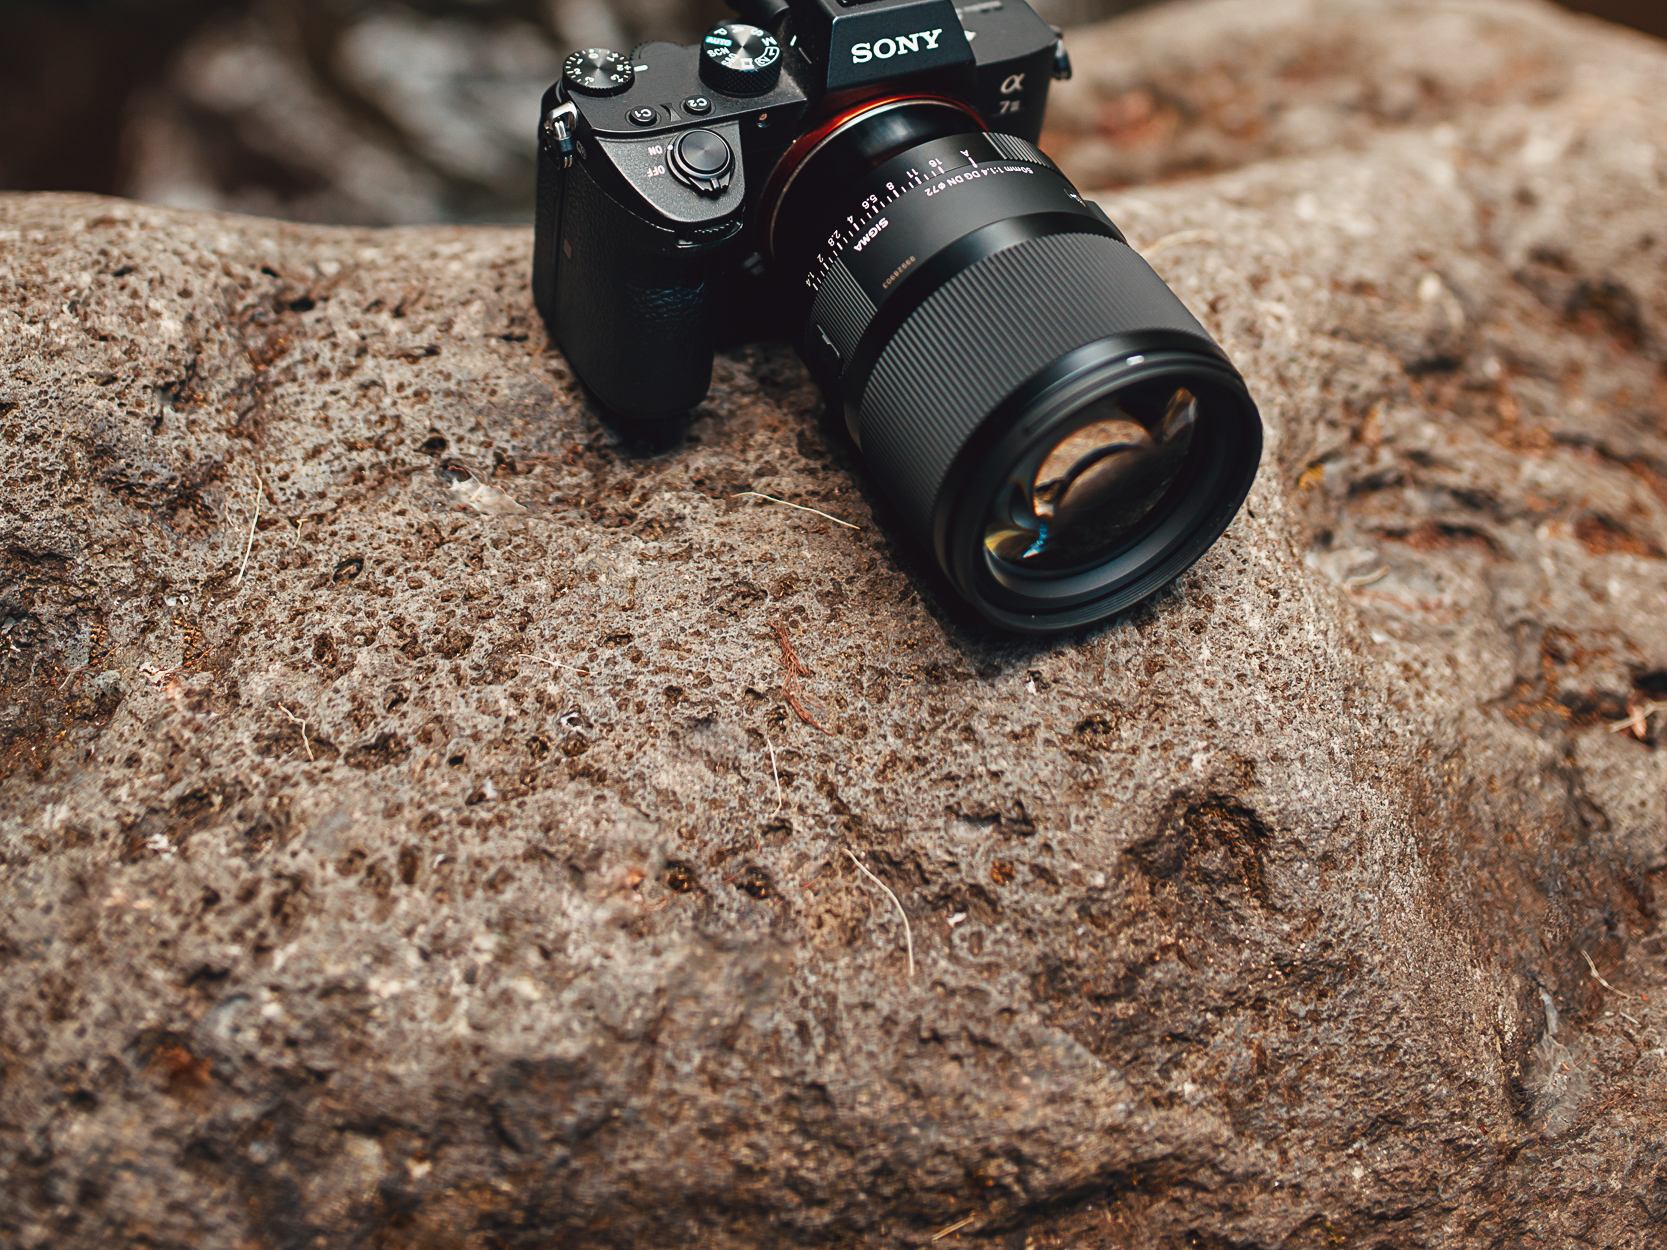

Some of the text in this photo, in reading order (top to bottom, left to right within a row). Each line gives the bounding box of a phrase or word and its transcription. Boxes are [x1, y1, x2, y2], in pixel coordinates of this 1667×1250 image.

[713, 27, 728, 36] P
[705, 36, 732, 46] AUTO
[761, 36, 777, 46] M
[850, 28, 943, 64] SONY
[707, 47, 730, 57] SCN
[687, 97, 708, 107] C2
[634, 108, 652, 117] C1
[648, 145, 663, 155] ON
[928, 157, 943, 168] 16
[646, 165, 666, 178] OFF
[906, 168, 919, 179] 11
[963, 169, 981, 181] DG
[981, 166, 1004, 176] 1:1.4
[1004, 165, 1034, 175] 50mm
[885, 181, 895, 191] 8
[946, 176, 964, 187] DN
[861, 194, 878, 210] 5.6
[846, 215, 854, 224] 4
[827, 229, 841, 247] 2.8
[853, 217, 889, 252] SIGMA
[816, 253, 824, 263] 2
[805, 271, 815, 287] 1.4
